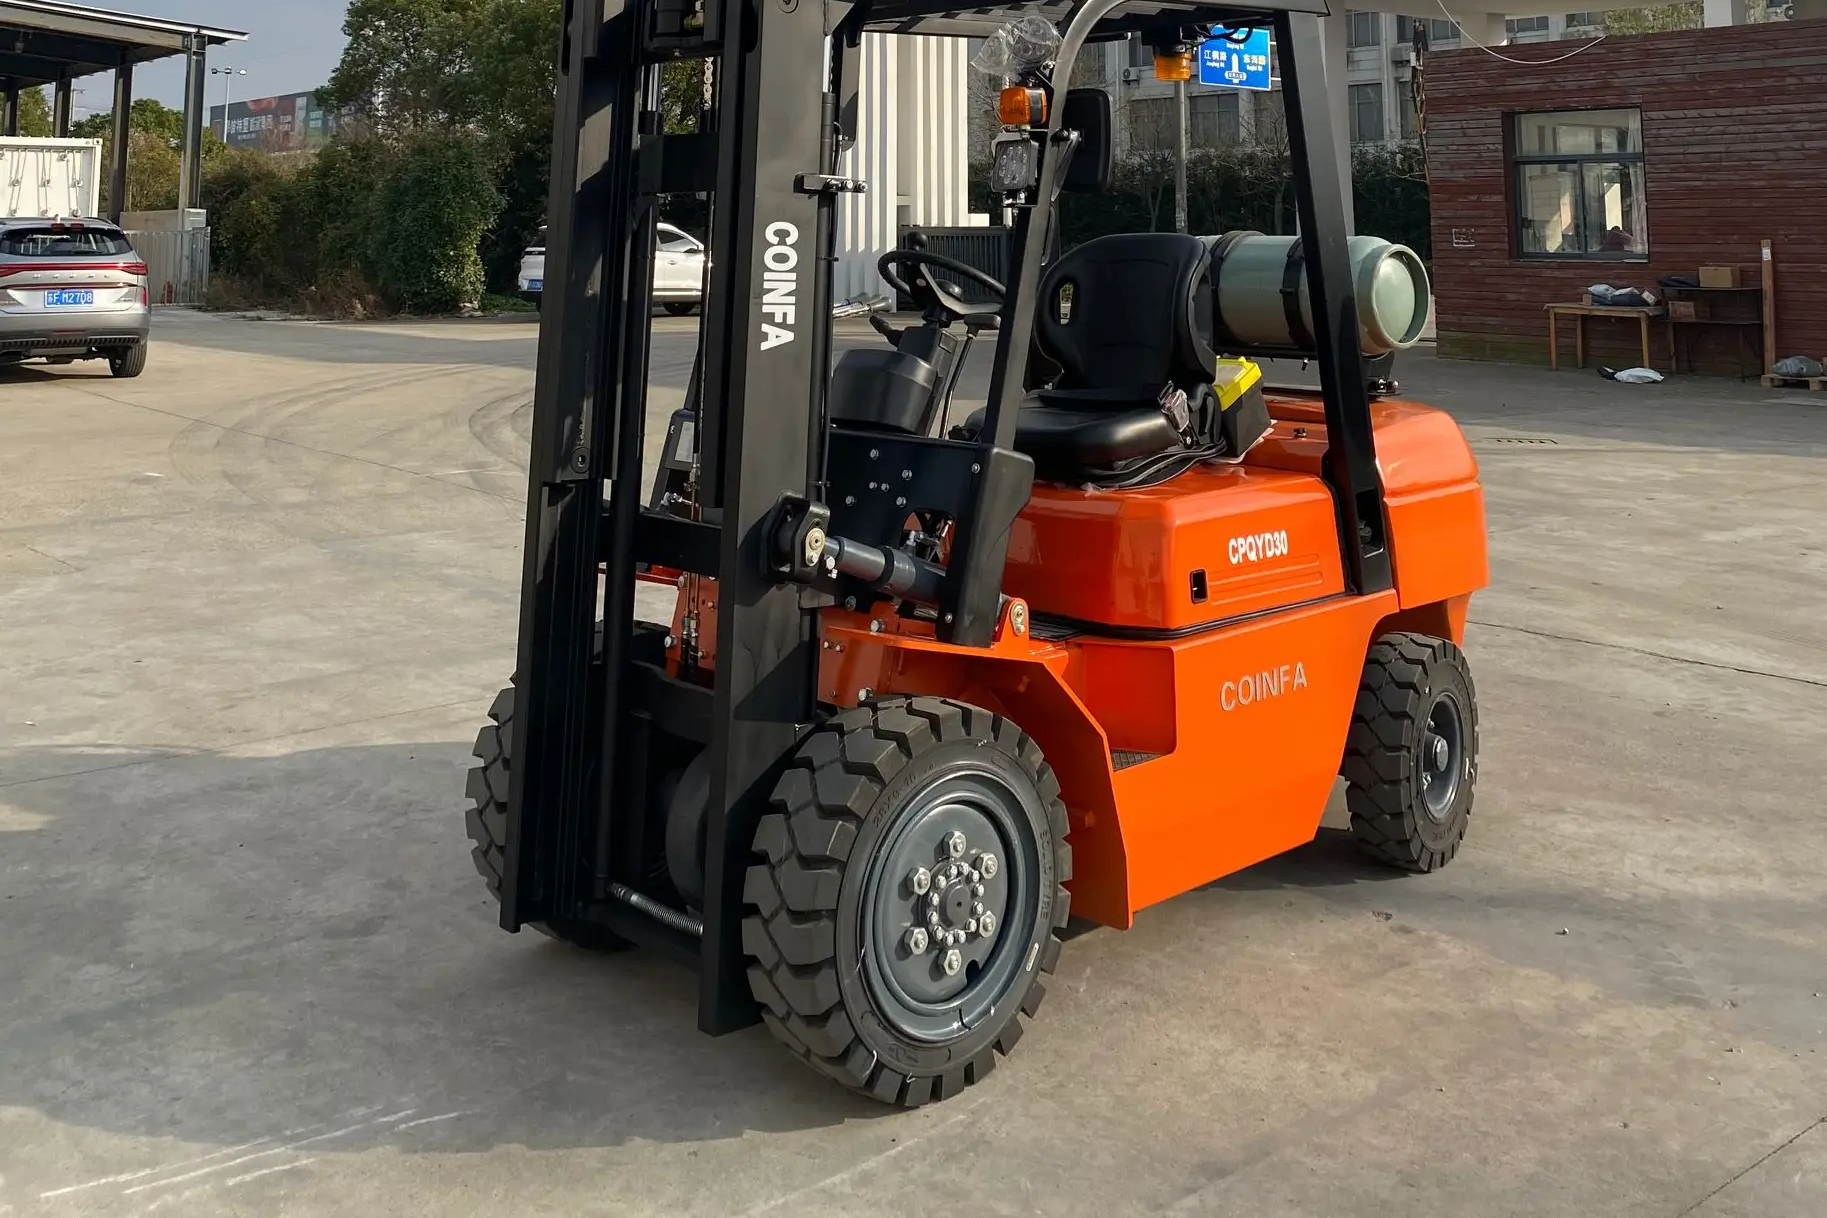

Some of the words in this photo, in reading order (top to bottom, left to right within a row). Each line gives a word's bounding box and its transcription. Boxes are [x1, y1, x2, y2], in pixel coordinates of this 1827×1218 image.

[760, 221, 799, 351] COINFA
[1228, 530, 1288, 565] CPQYD30
[1220, 661, 1308, 711] COINFA
